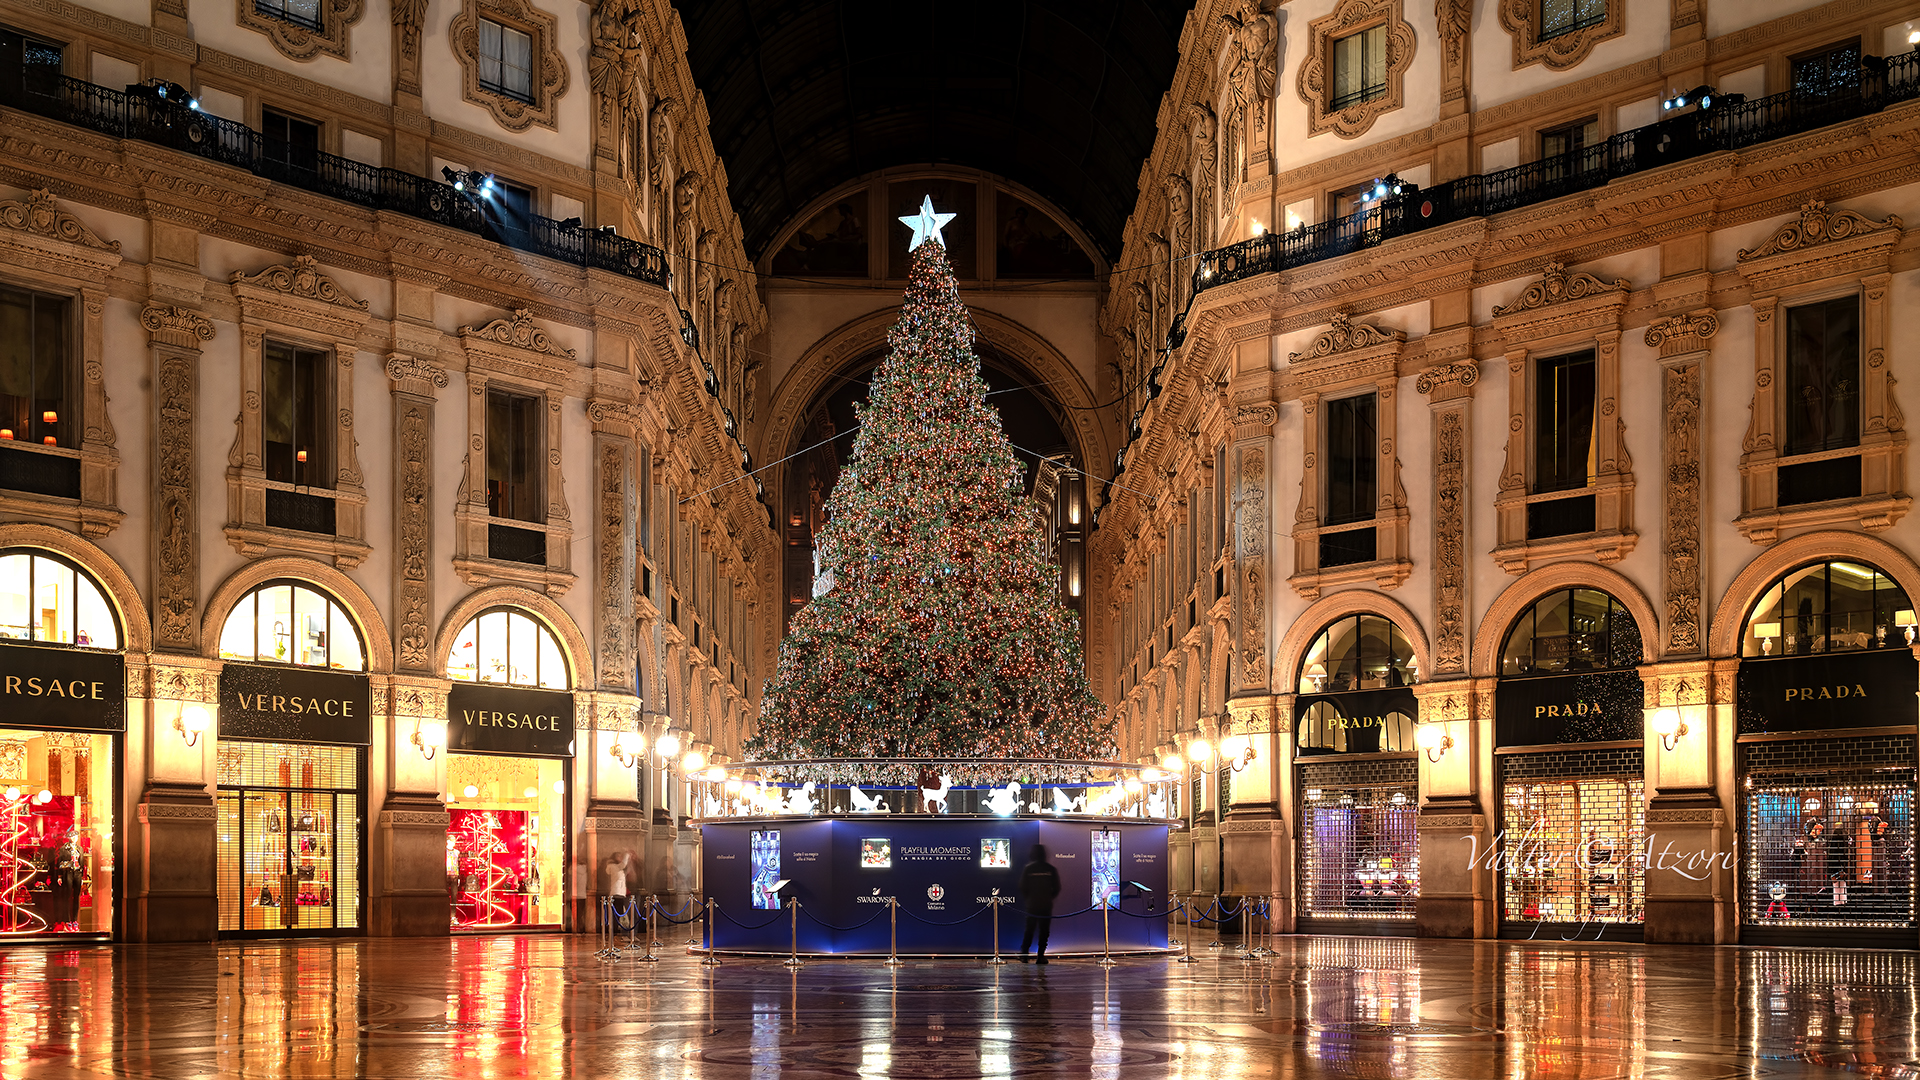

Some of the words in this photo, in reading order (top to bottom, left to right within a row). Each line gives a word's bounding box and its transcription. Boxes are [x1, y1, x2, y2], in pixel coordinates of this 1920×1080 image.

[5, 675, 104, 700] RSACE
[1785, 684, 1867, 702] PRADA
[238, 692, 354, 718] VERSACE
[1534, 702, 1603, 718] PRADA
[463, 709, 560, 732] VERSACE
[1327, 715, 1386, 730] PRADA
[900, 846, 928, 854] PLAYFUL
[930, 846, 971, 854] MOMENTS
